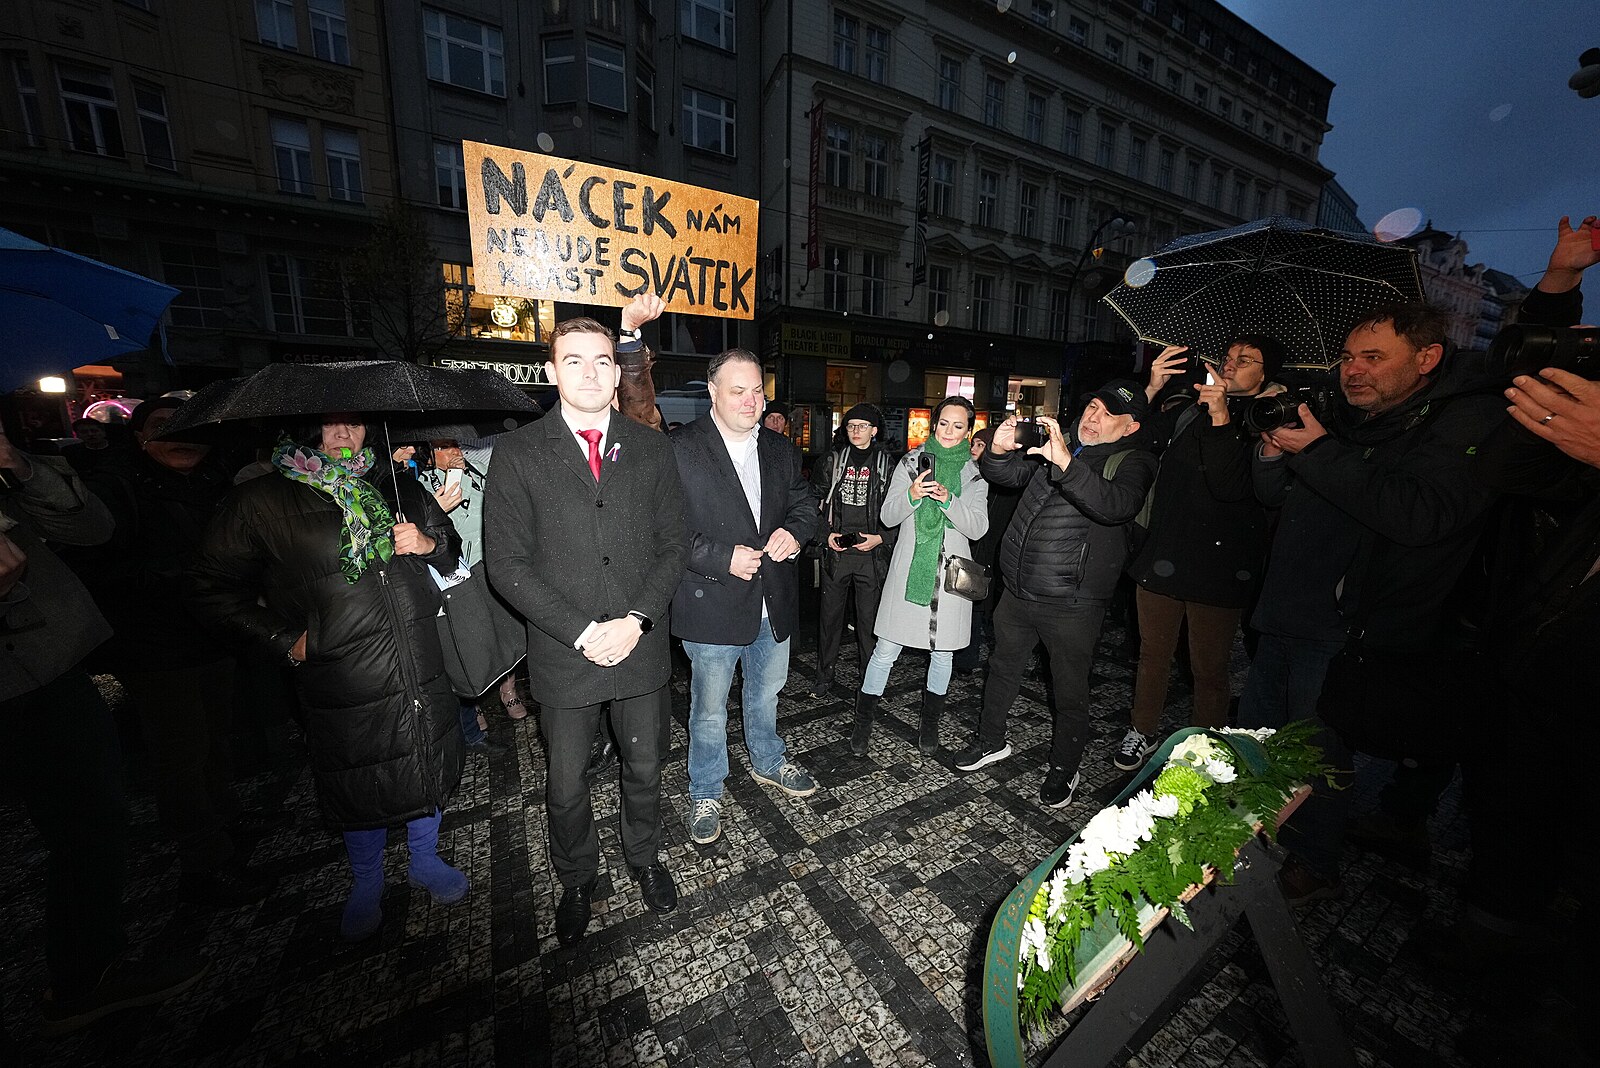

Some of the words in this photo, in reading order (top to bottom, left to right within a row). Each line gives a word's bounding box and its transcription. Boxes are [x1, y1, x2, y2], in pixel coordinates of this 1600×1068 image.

[481, 157, 677, 239] NÁCEK
[686, 204, 740, 234] NÁM
[919, 153, 930, 209] IMAGE
[615, 246, 753, 313] SVÁTEK
[783, 340, 819, 354] THEATRE
[821, 343, 849, 356] METRO
[790, 328, 817, 341] BLACK
[820, 331, 842, 344] LIGHT
[855, 333, 884, 347] DIVADLO
[887, 337, 911, 350] METRO
